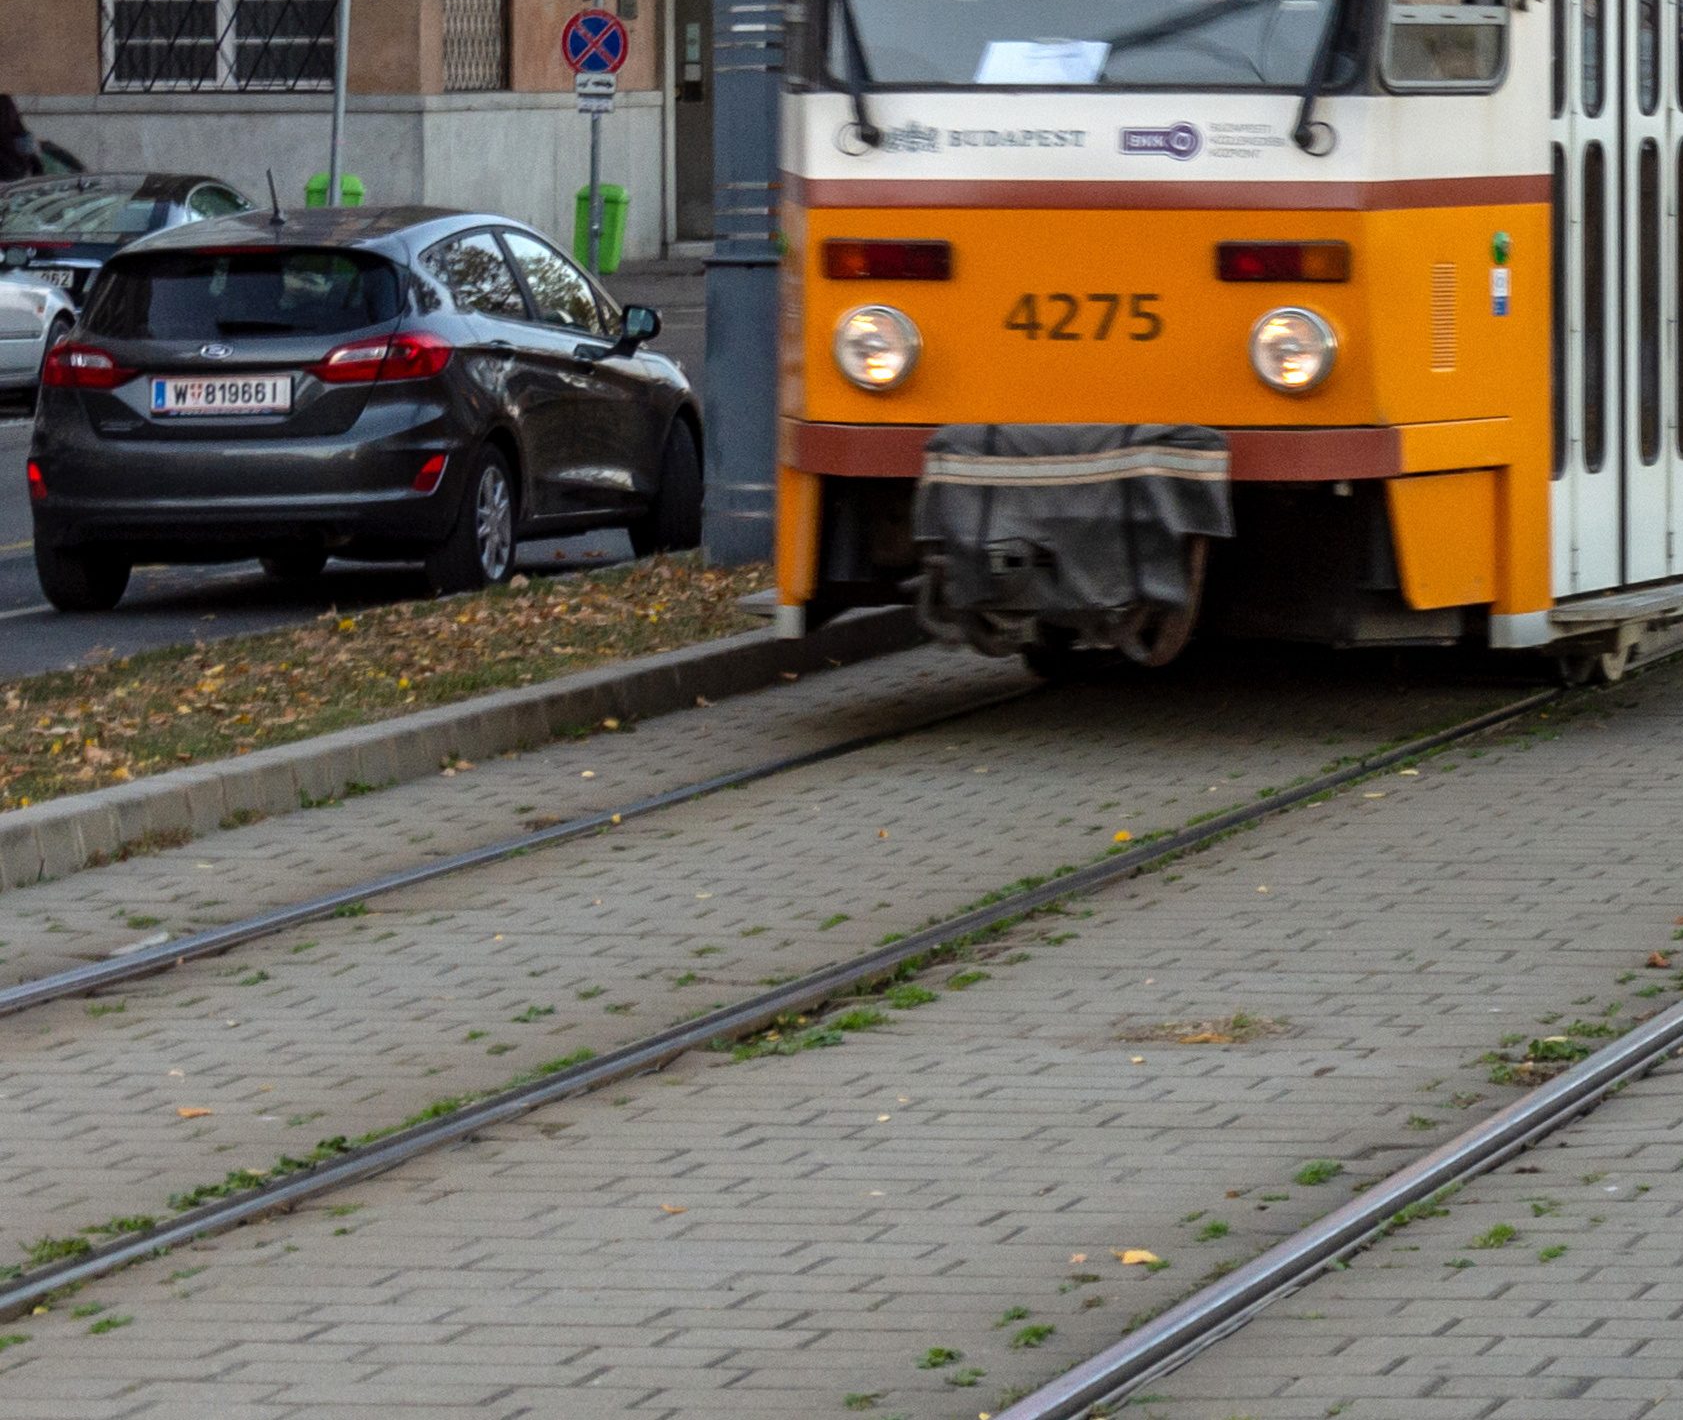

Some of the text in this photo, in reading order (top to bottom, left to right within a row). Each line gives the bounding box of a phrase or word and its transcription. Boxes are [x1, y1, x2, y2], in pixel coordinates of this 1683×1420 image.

[946, 128, 1088, 148] BUDAPEST
[1004, 293, 1164, 341] 4275
[173, 383, 188, 405] W
